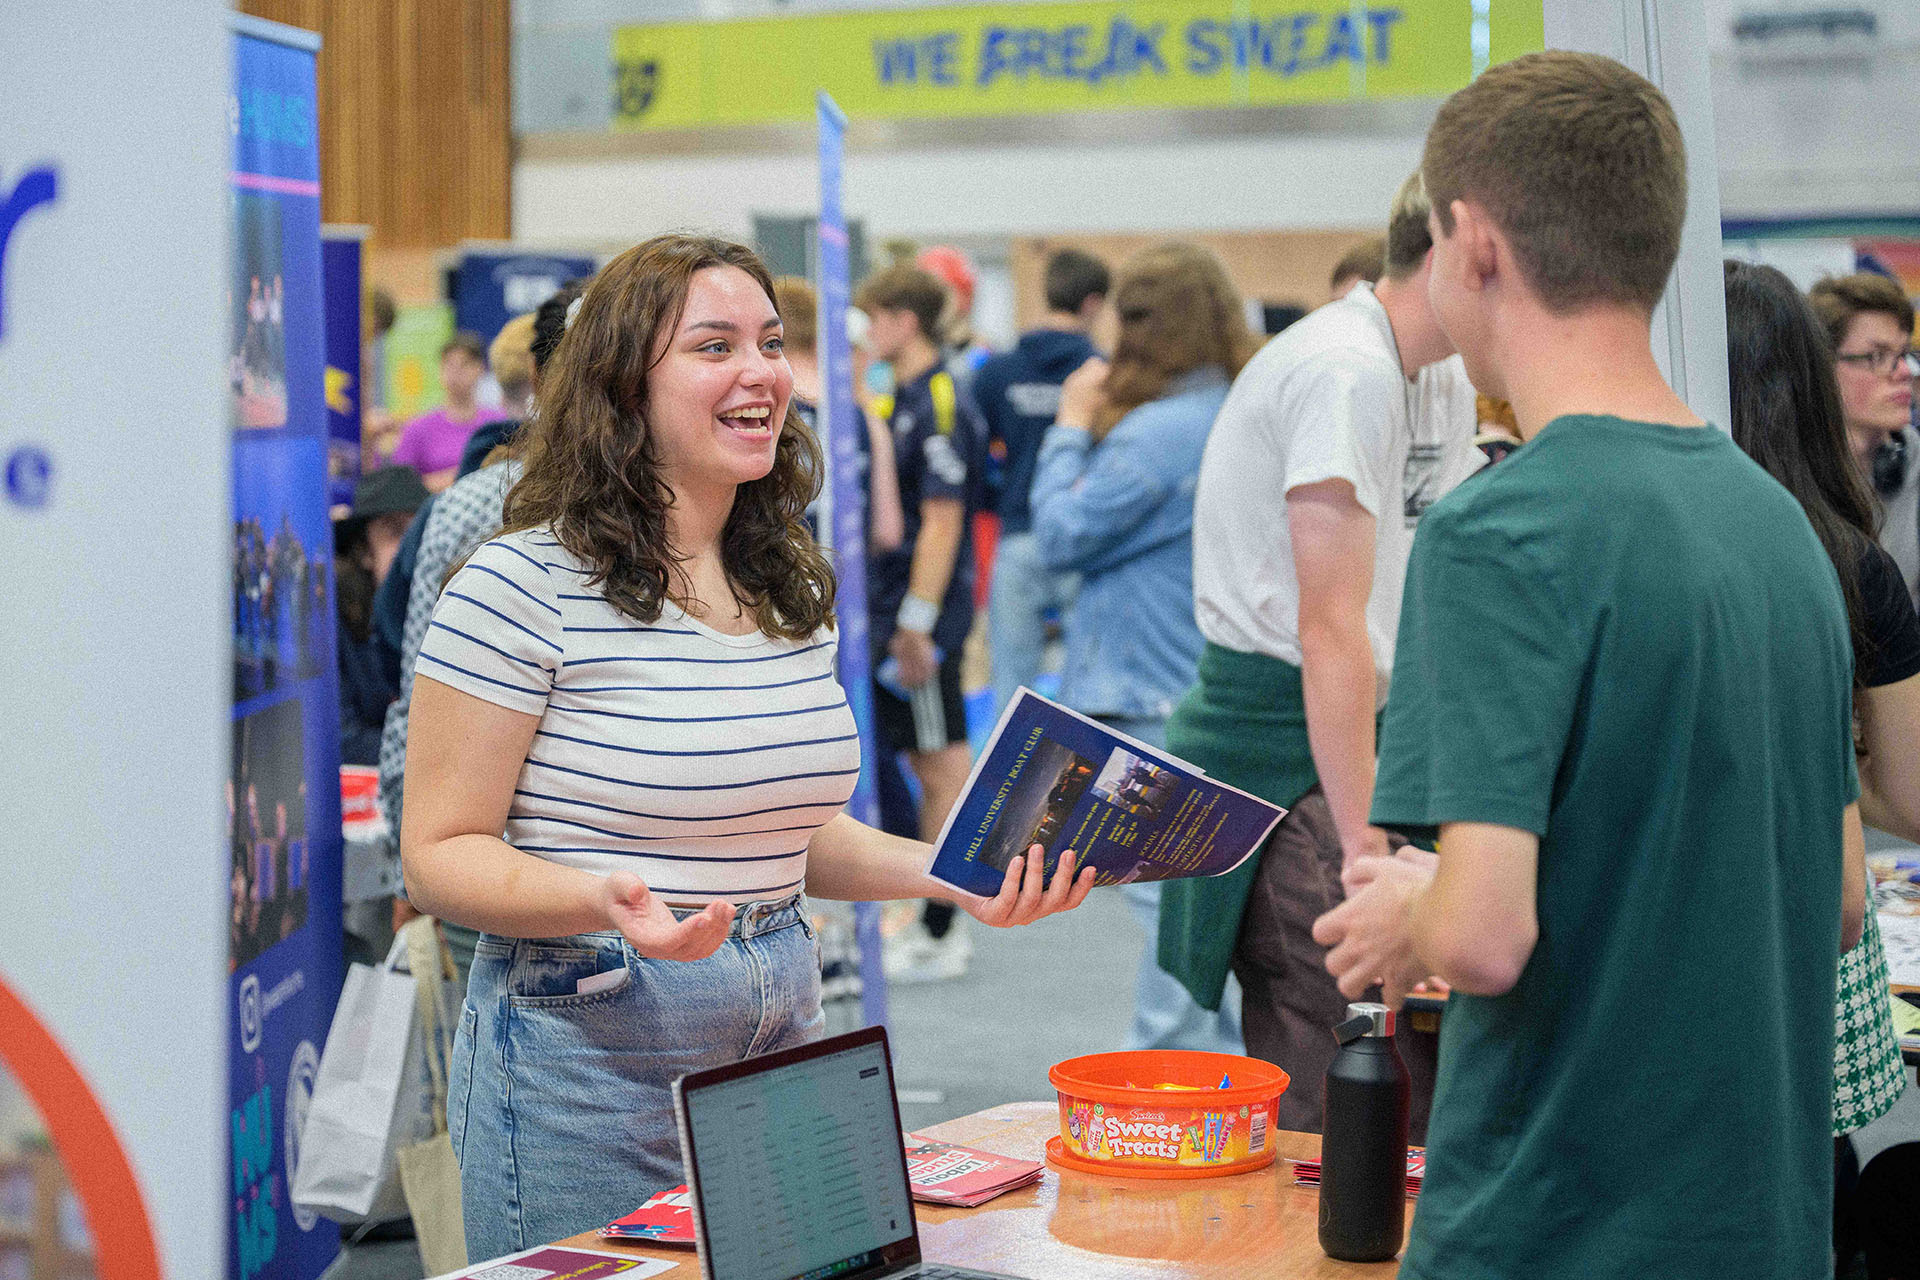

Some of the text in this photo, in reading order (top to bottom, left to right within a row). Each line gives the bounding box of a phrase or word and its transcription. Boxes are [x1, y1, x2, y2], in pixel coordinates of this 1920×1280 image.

[873, 34, 959, 86] WE
[1183, 9, 1403, 77] SWEAT
[964, 726, 1044, 862] HULL UNIVERSITY BOAT CLUB
[1105, 1116, 1182, 1142] Sweet
[1108, 1136, 1180, 1159] Treats
[909, 1152, 965, 1177] Stude
[920, 1160, 980, 1185] Labour
[977, 1160, 1001, 1173] Join
